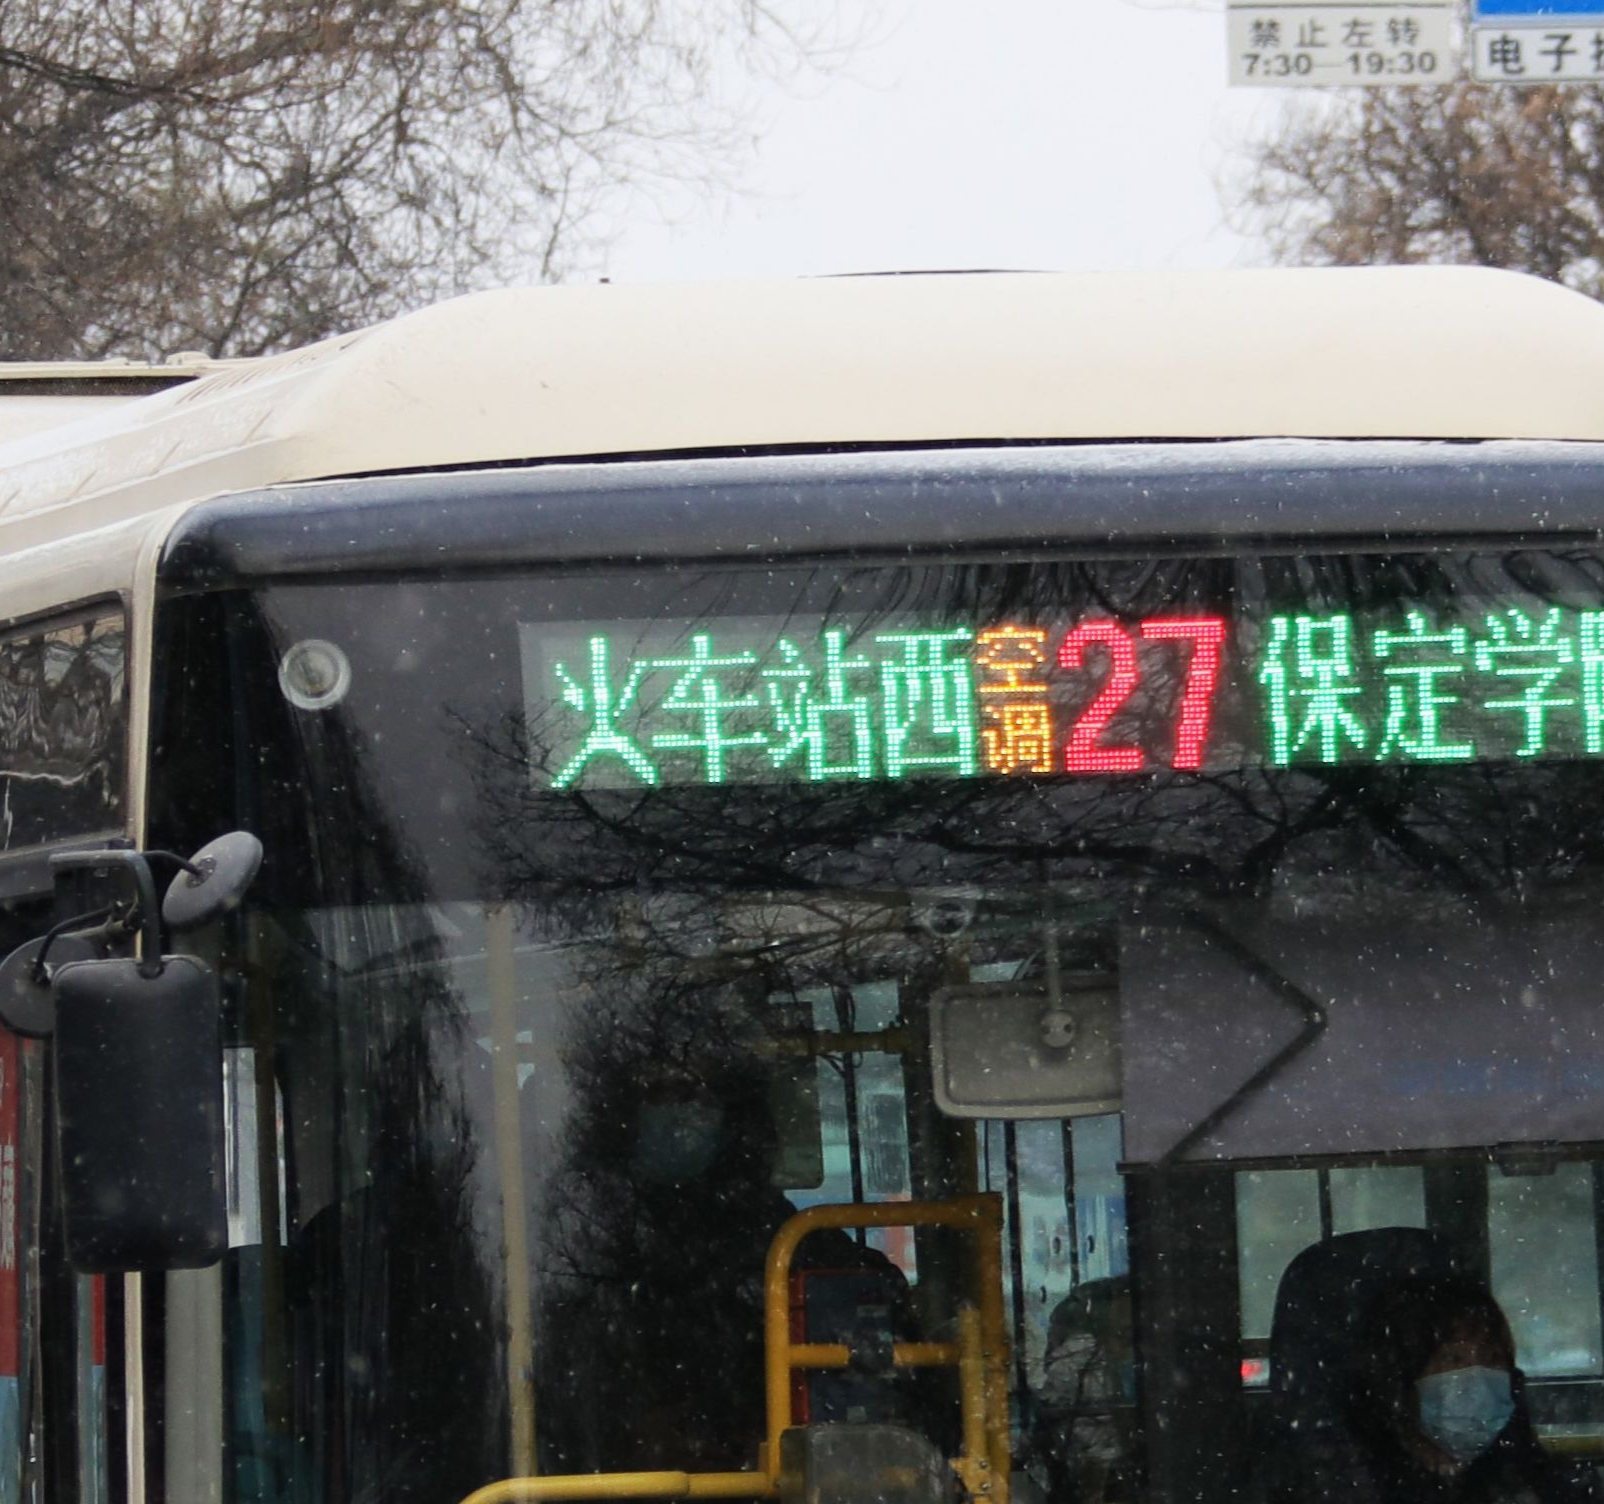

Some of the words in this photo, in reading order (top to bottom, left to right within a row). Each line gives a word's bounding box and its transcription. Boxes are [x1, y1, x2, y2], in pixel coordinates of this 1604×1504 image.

[1248, 17, 1421, 50] 禁止左转
[551, 624, 975, 788] 火车站西
[976, 626, 1054, 774] 空调
[1056, 616, 1227, 771] 27
